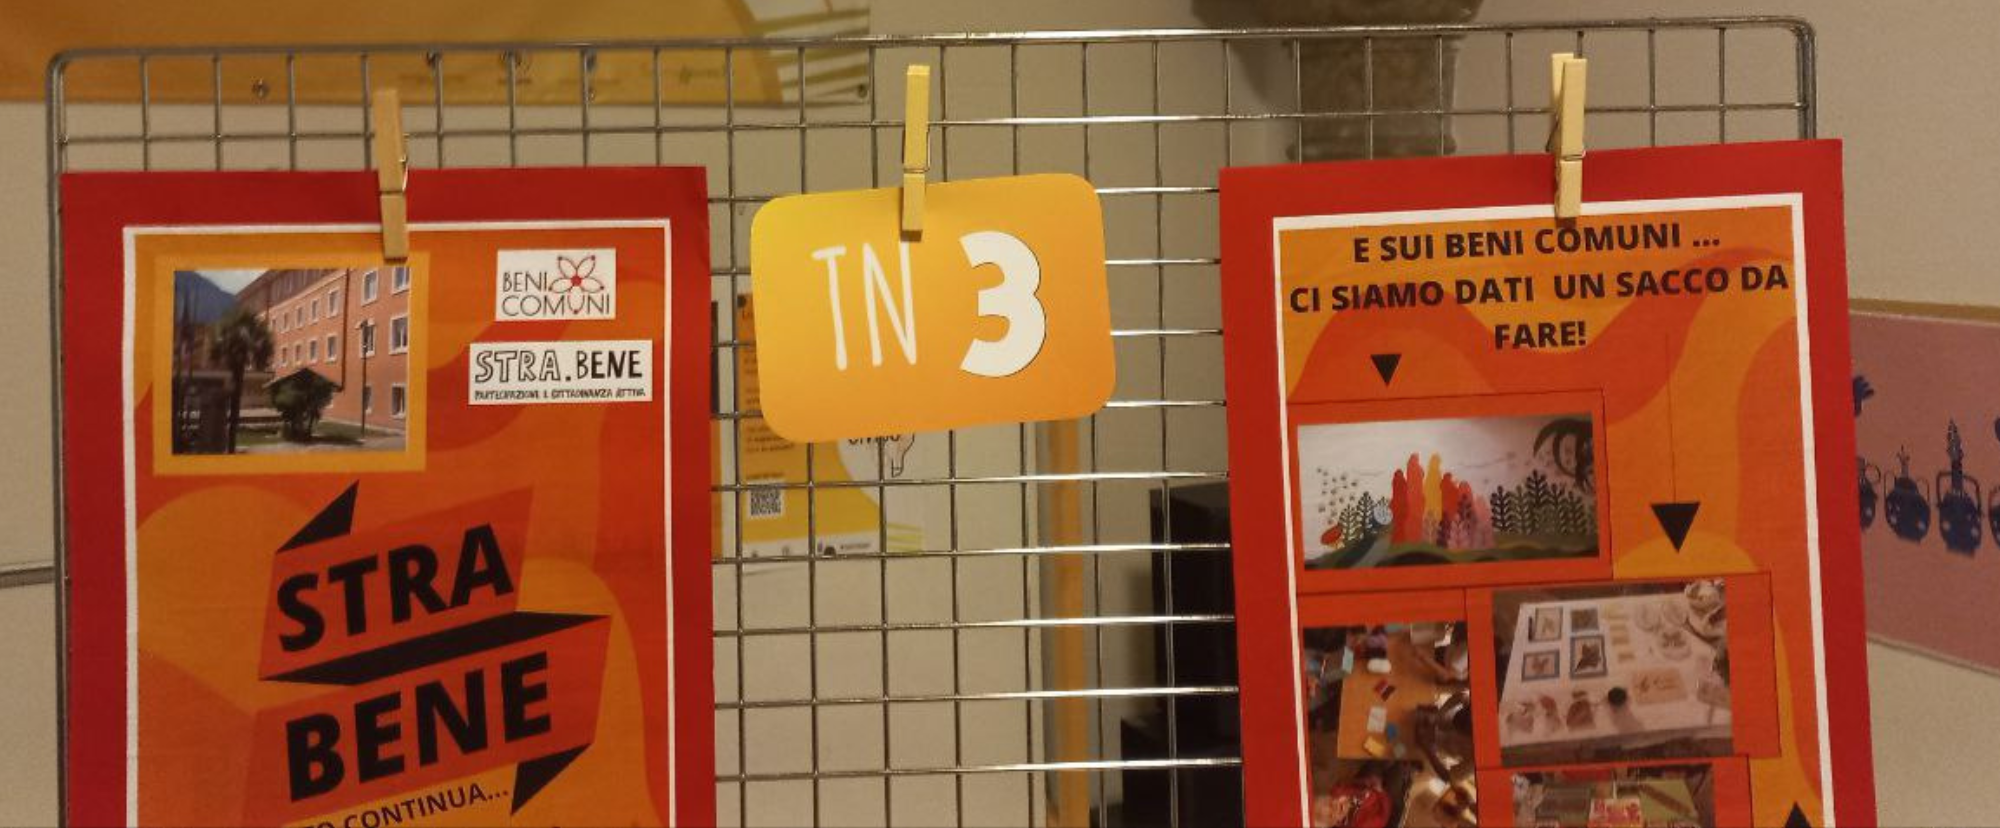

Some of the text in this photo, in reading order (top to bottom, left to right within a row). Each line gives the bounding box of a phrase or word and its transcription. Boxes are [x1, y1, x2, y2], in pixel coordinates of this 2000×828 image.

[1353, 237, 1370, 263] E
[1380, 235, 1434, 262] SUI
[1446, 230, 1524, 258] BENI
[1535, 223, 1680, 254] COMUNI
[502, 270, 548, 293] BENI
[811, 229, 1047, 378] TN 3
[1289, 264, 1789, 313] CI SIAMO DATI UN SACCO DA
[501, 294, 611, 317] COMUNI
[1494, 320, 1587, 350] FARE!
[277, 523, 514, 652] STRA
[286, 651, 551, 801] BENE
